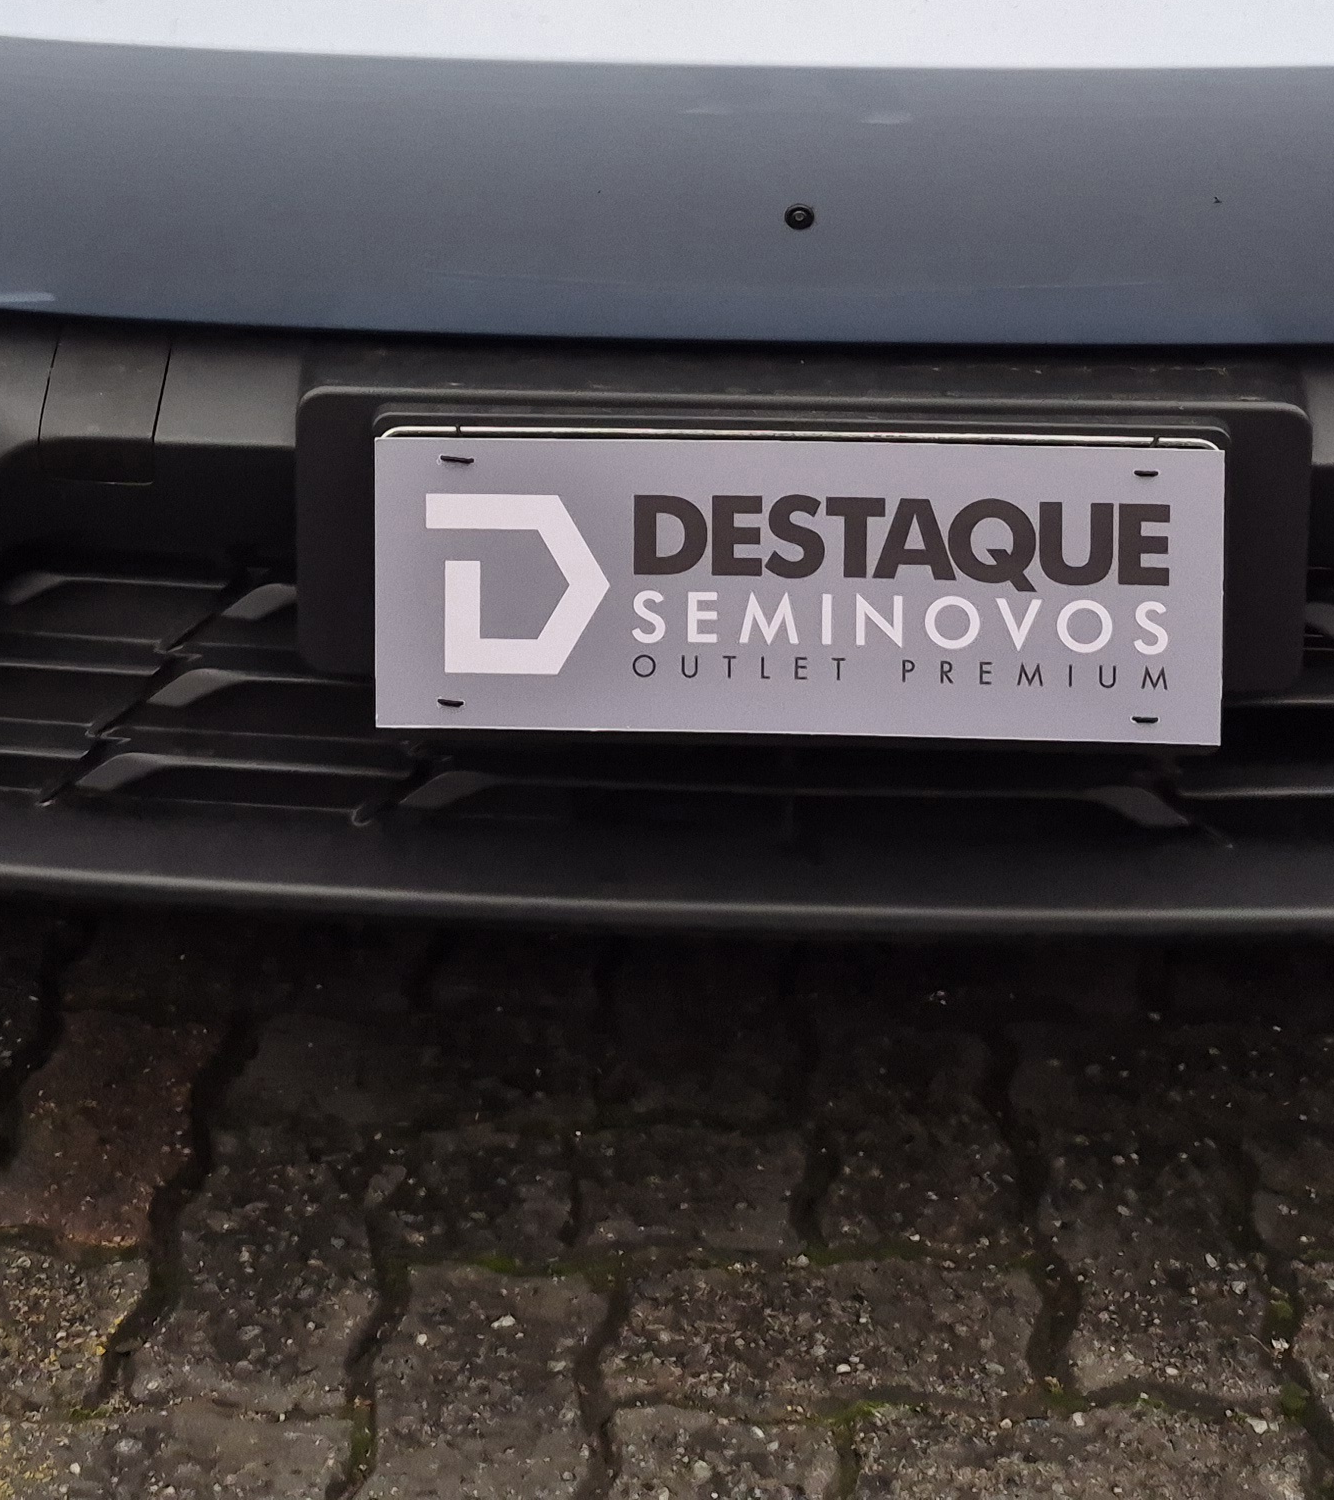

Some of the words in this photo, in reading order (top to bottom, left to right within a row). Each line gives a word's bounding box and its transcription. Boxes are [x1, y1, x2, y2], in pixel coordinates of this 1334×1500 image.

[632, 494, 1171, 592] DESTAQUE
[631, 590, 1170, 655] SEMINOVOS
[631, 654, 847, 682] OUTLET
[901, 659, 1169, 691] PREMIUM
